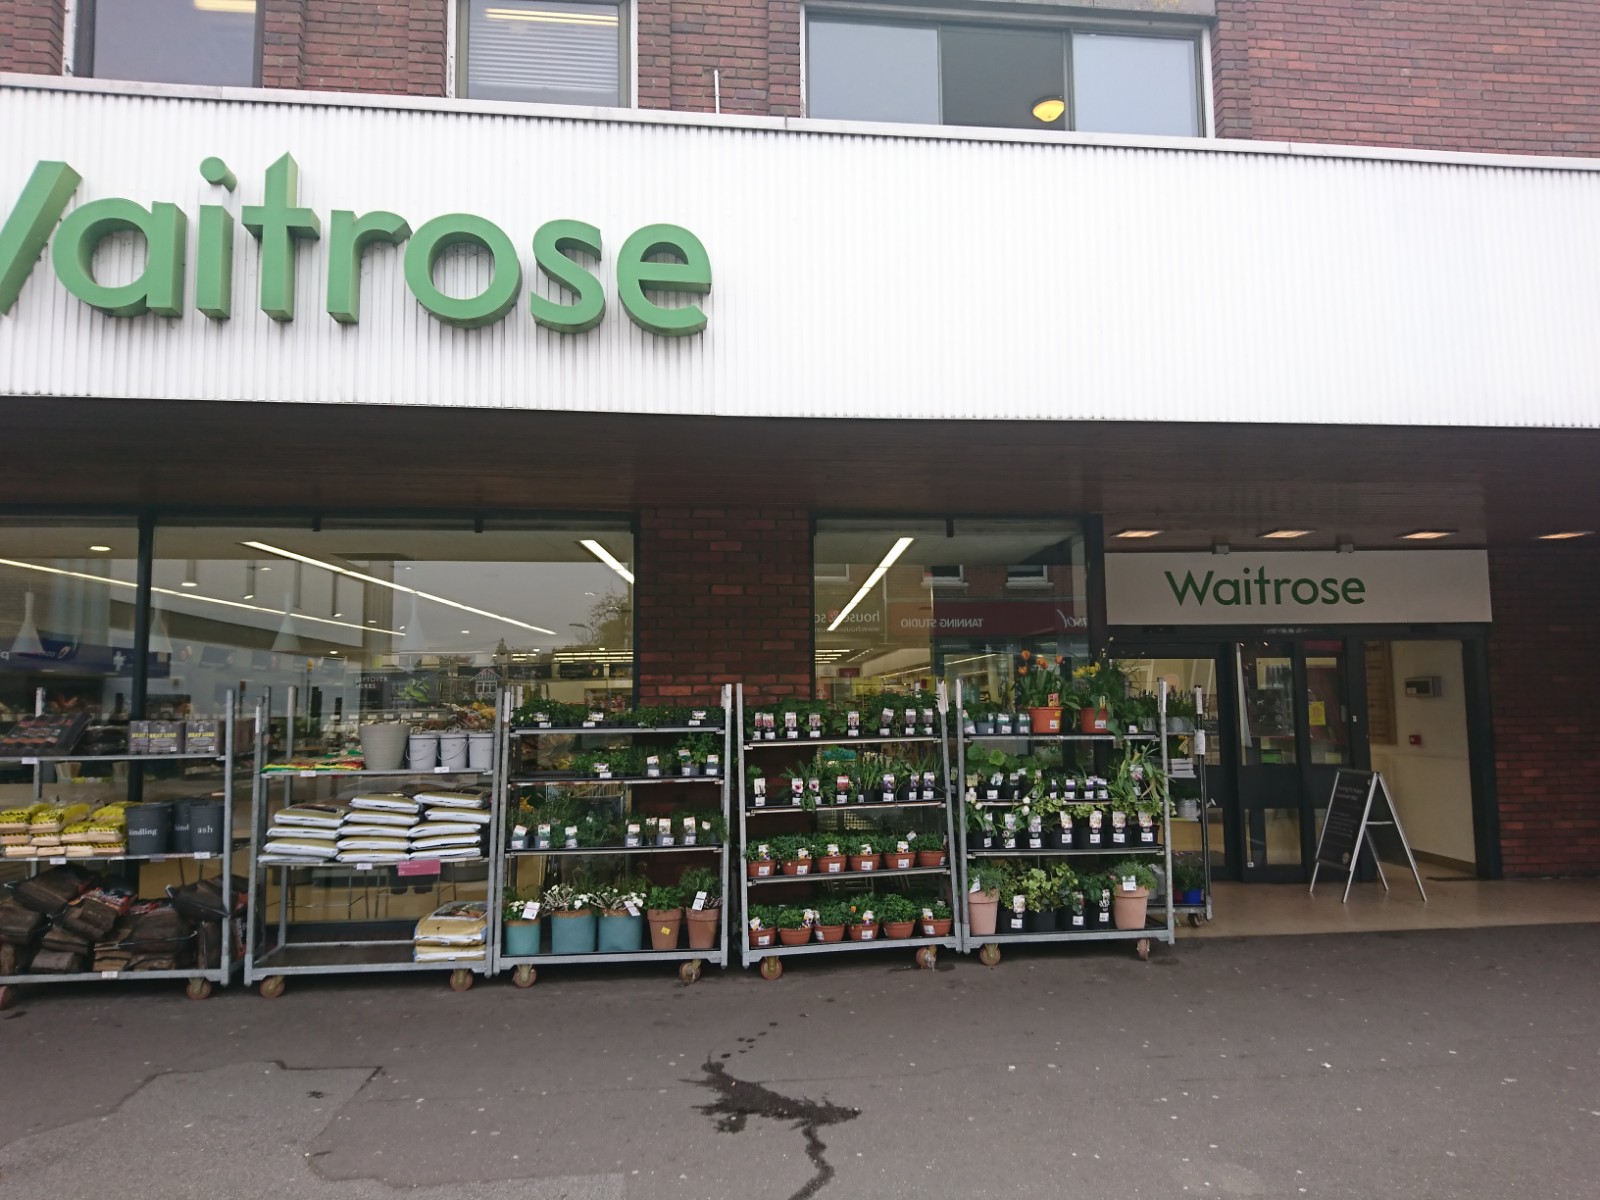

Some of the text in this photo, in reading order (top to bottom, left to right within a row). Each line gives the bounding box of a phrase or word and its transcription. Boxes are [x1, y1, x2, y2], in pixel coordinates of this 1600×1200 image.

[0, 151, 712, 337] aitrose
[1164, 565, 1366, 606] Waitrose
[197, 824, 213, 834] ash
